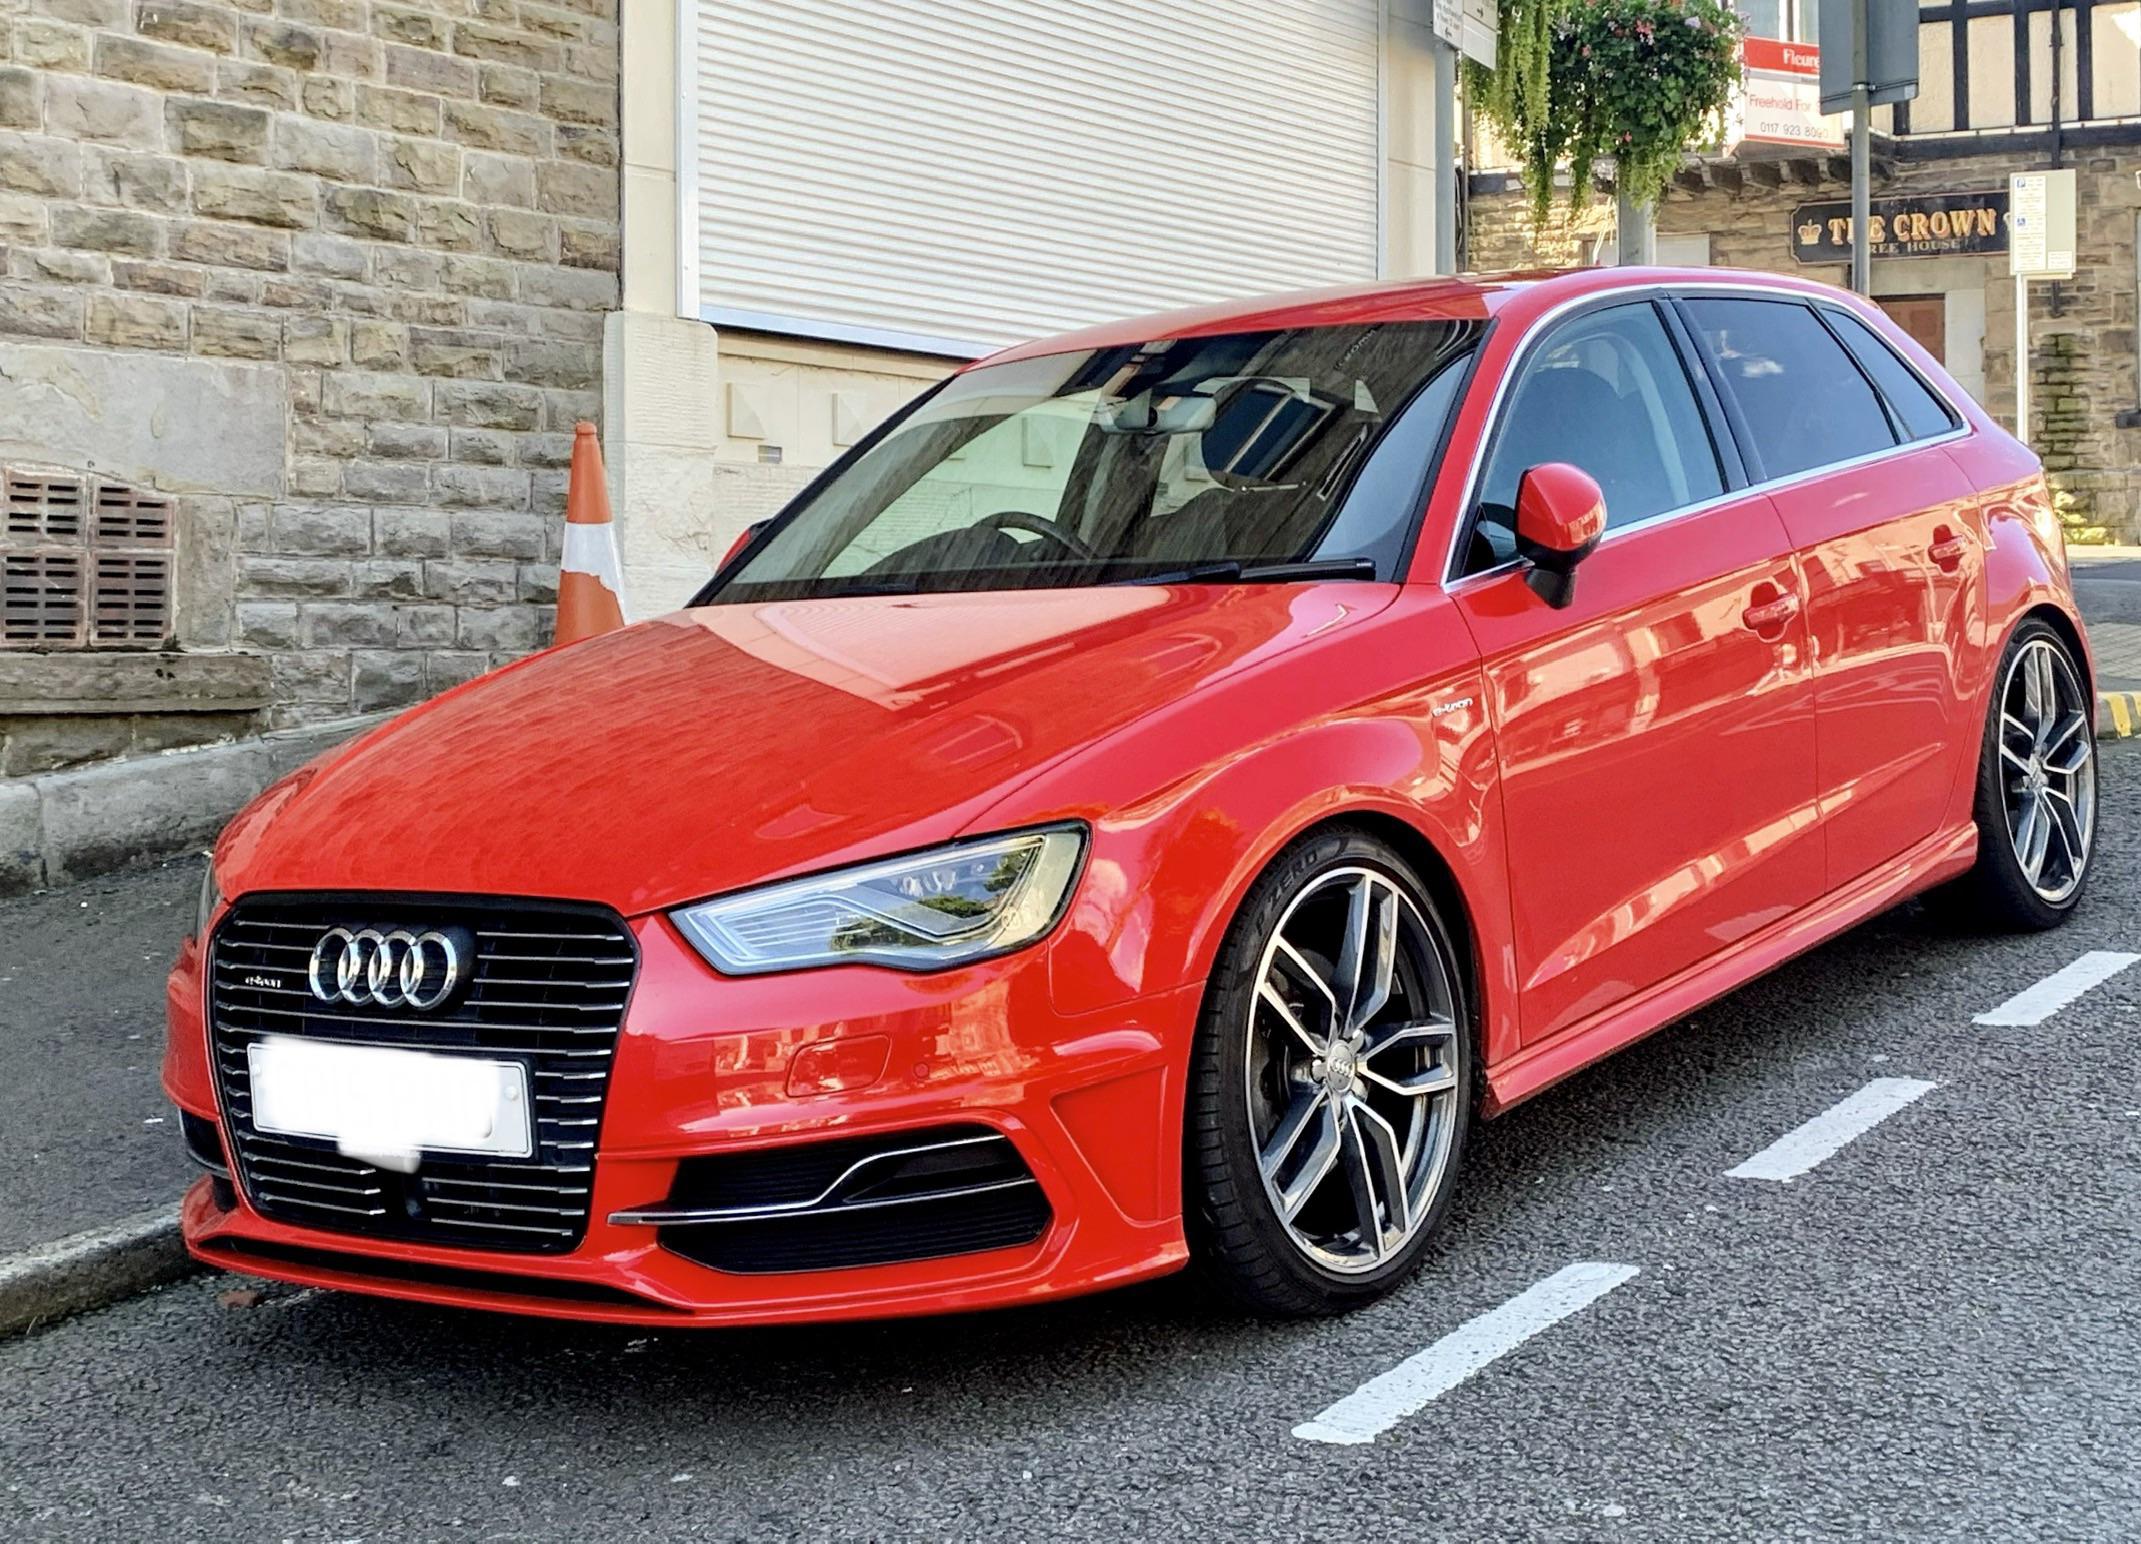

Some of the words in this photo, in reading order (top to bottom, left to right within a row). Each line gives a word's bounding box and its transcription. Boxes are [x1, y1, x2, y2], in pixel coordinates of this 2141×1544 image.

[1749, 94, 1793, 111] Freehold
[1795, 98, 1811, 112] For
[1760, 121, 1779, 134] 0117
[1783, 123, 1801, 137] 923
[1893, 209, 1997, 241] CROWN
[1869, 242, 1900, 254] REE
[1907, 239, 1961, 253] HOUSE
